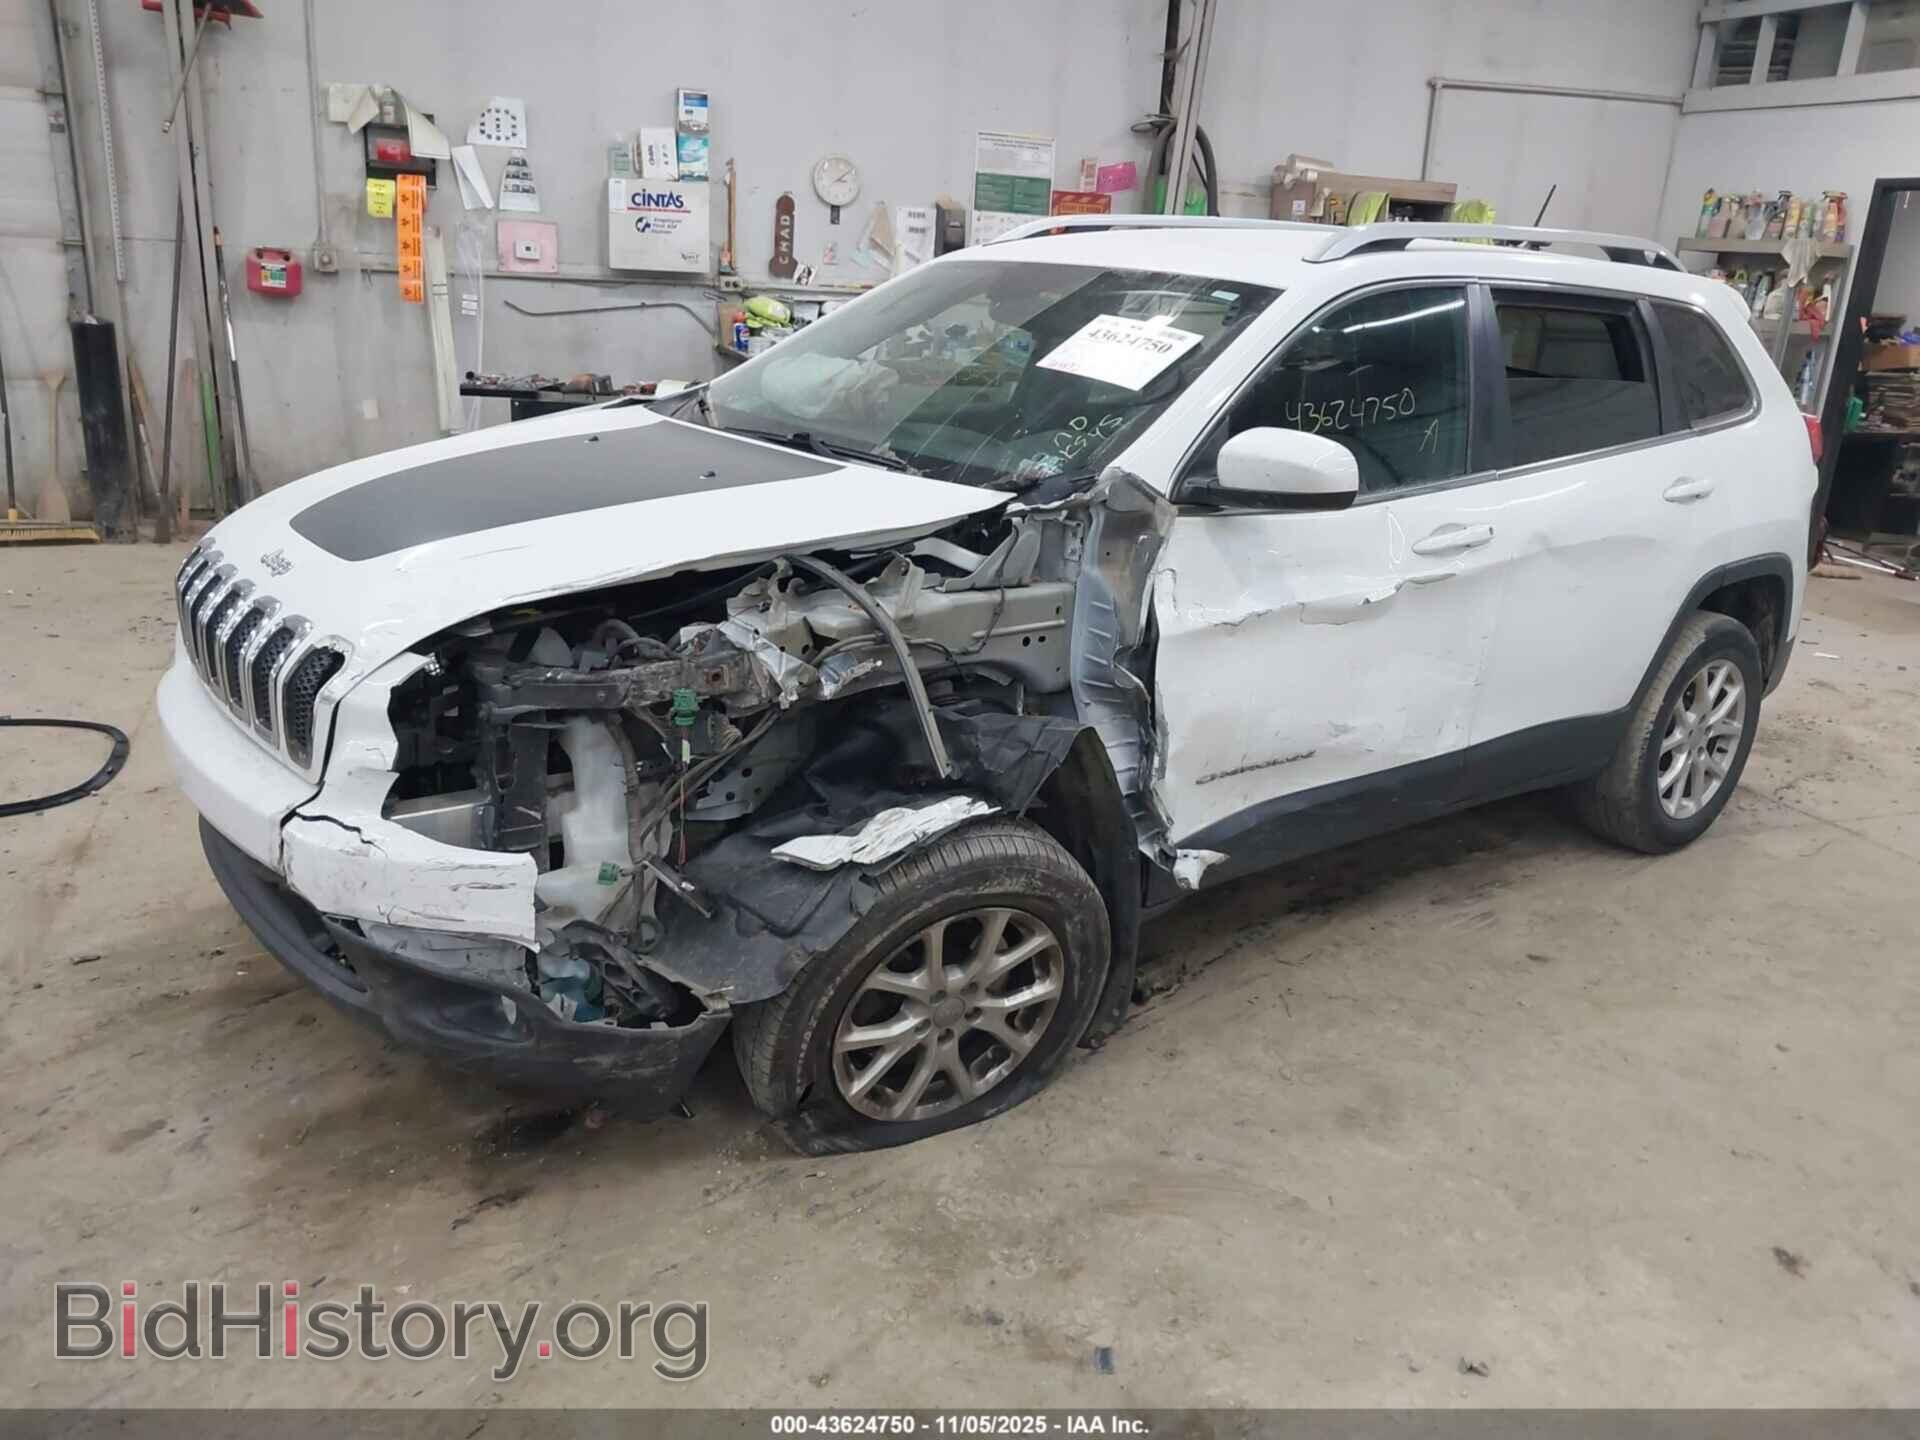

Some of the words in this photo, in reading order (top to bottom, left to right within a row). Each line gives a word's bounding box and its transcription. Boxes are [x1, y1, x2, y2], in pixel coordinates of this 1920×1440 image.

[779, 215, 791, 265] CHAD
[1088, 328, 1174, 354] 43624750
[1285, 387, 1416, 434] 43624750
